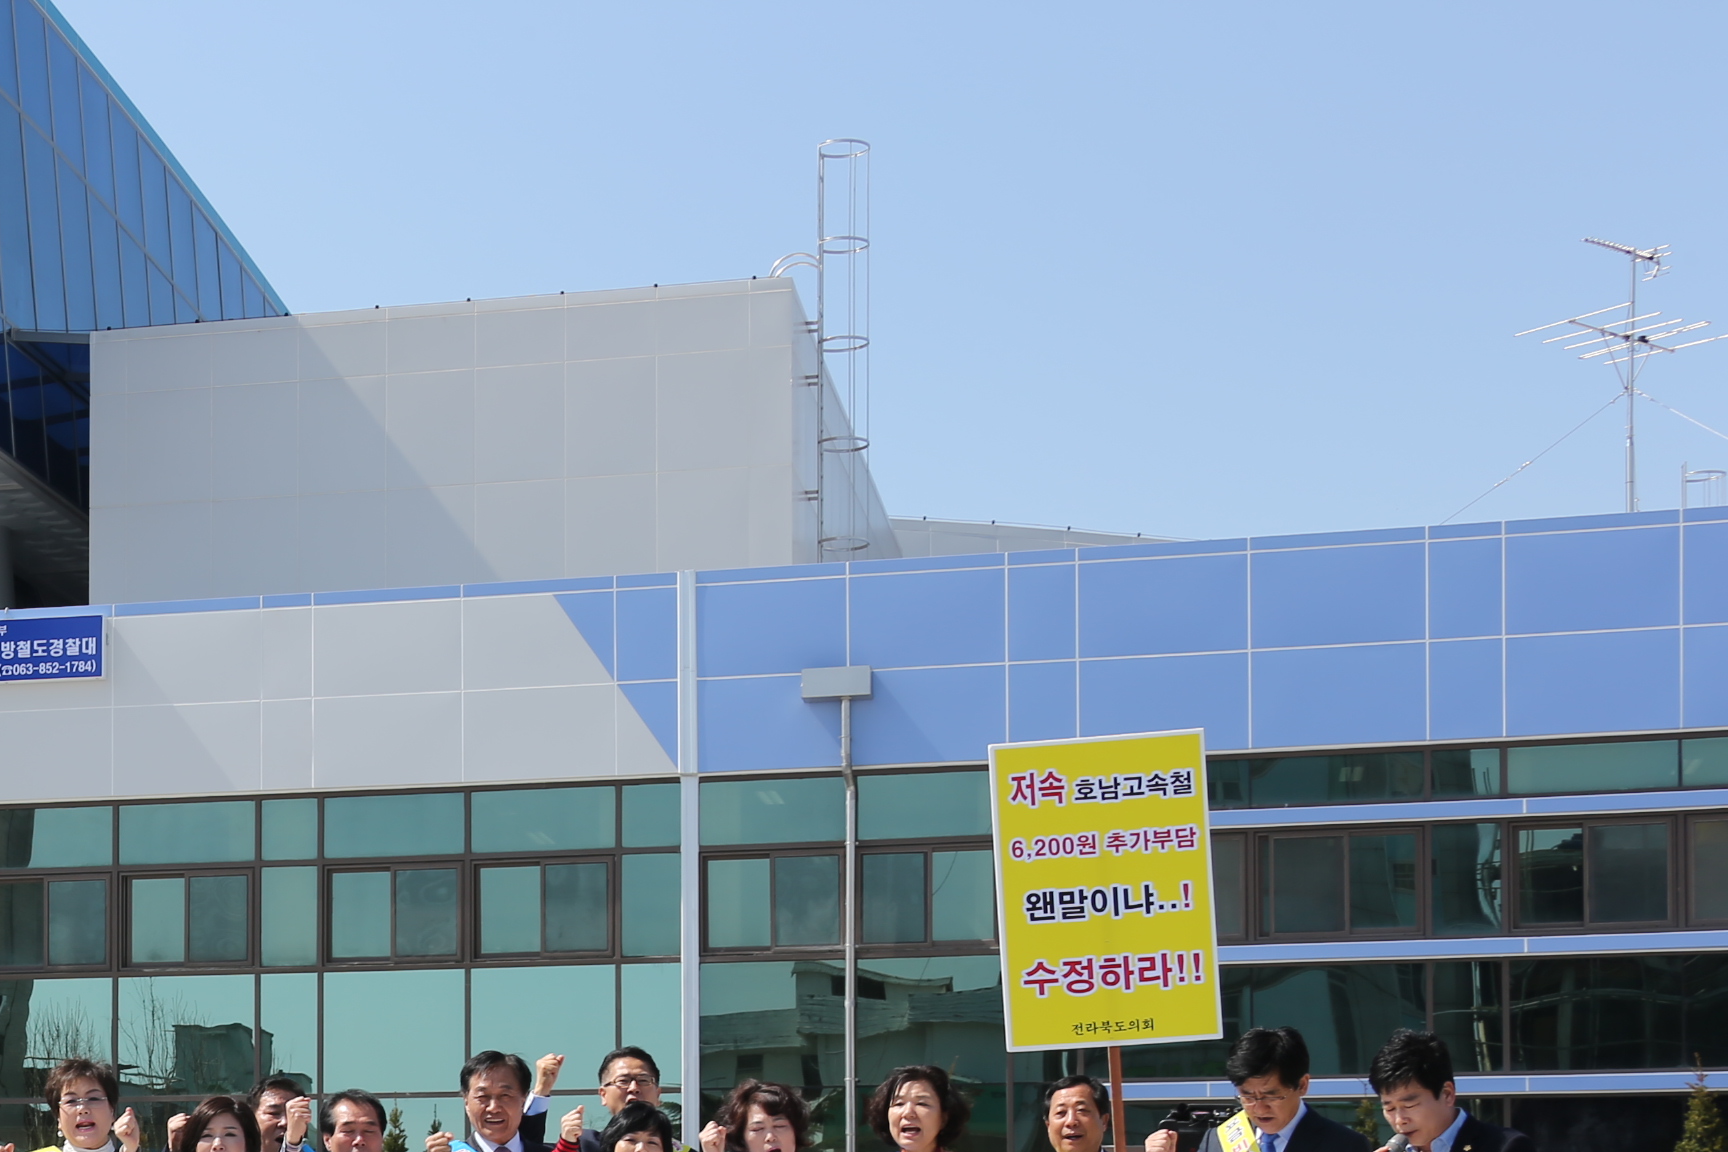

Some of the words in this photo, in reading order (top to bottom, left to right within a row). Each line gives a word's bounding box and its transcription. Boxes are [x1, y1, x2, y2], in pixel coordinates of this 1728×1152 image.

[1010, 768, 1066, 807] 저속
[1074, 769, 1193, 802] 호남고속철
[1010, 832, 1098, 860] 6,200원
[1105, 826, 1197, 855] 추가부담
[1022, 951, 1203, 997] 수정하라!!
[1071, 1017, 1156, 1036] 전라북도의회
